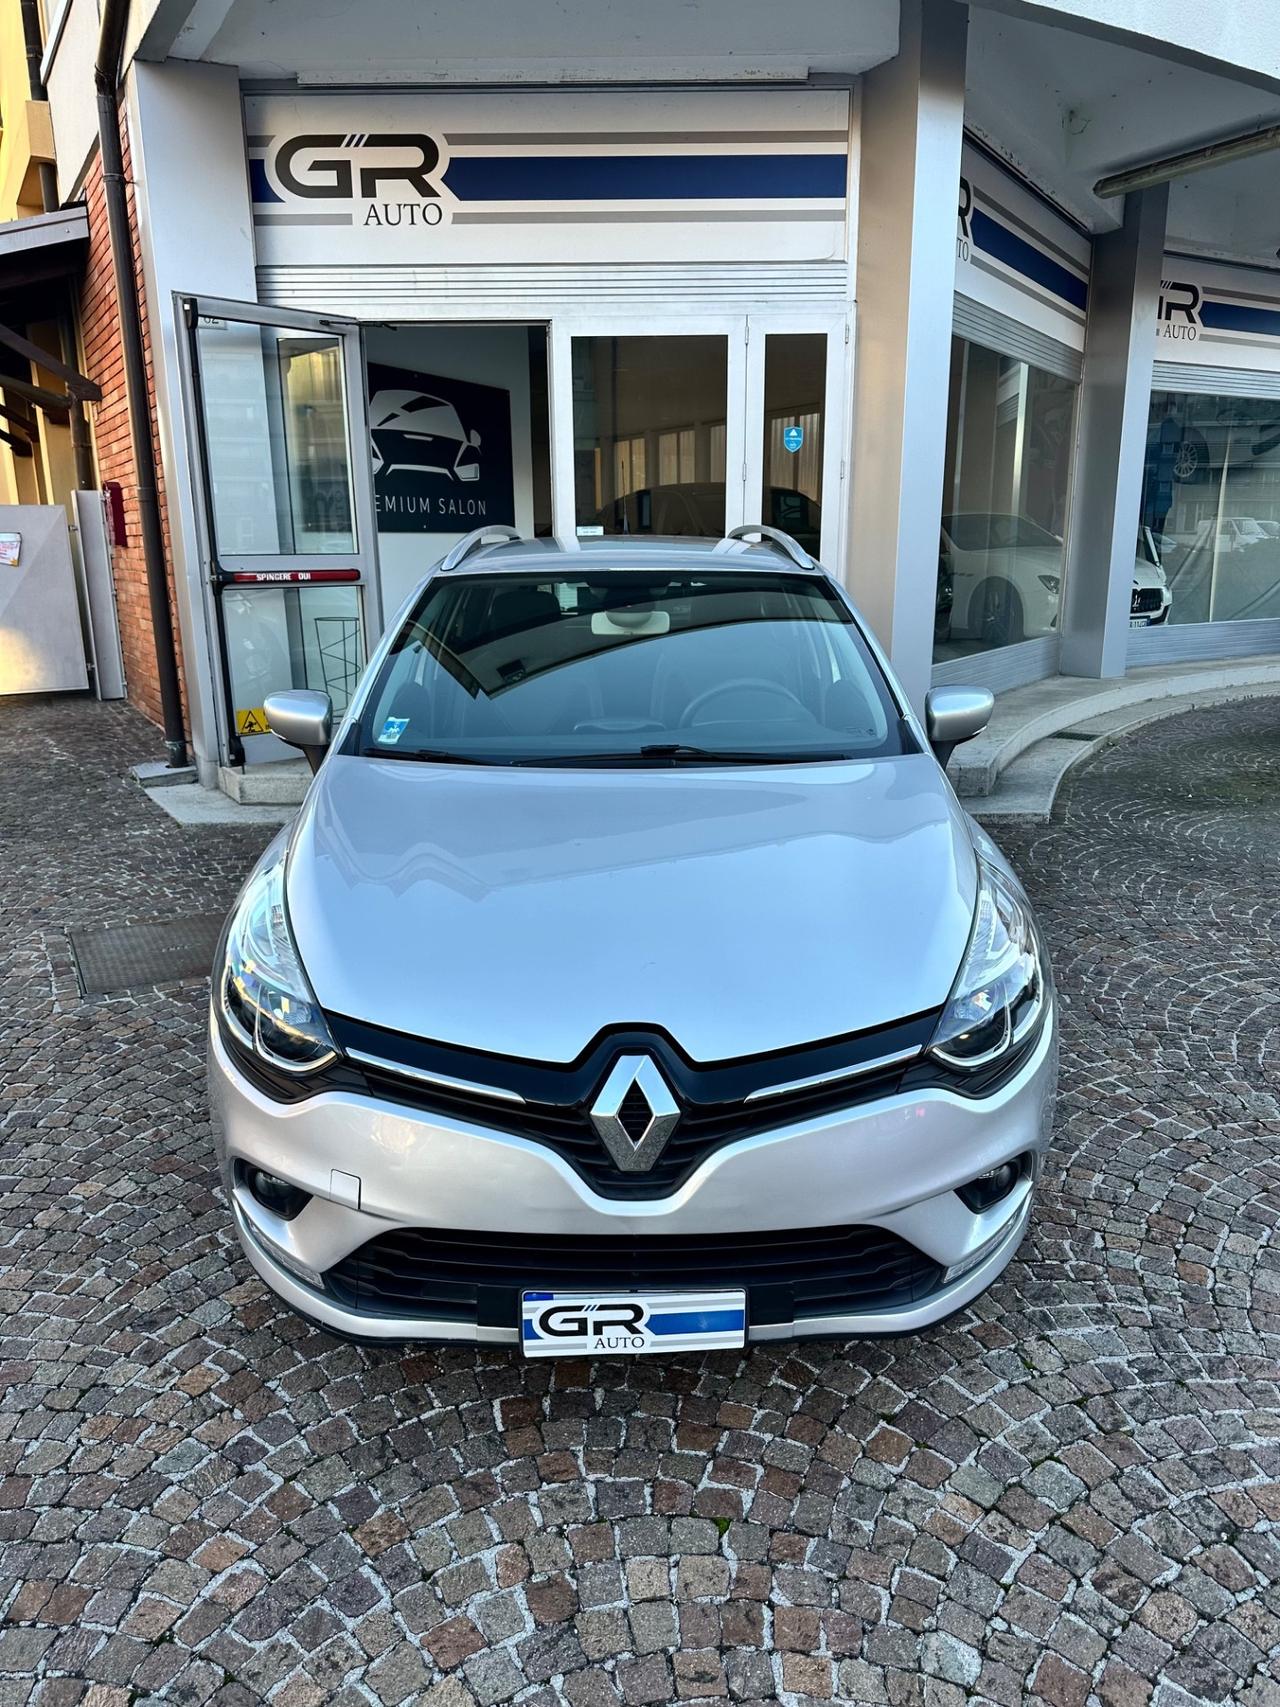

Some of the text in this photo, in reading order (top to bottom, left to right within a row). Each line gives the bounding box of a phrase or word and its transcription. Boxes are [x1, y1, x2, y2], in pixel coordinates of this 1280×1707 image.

[275, 133, 442, 199] GR
[363, 202, 443, 226] AUTO
[1157, 279, 1200, 324] R
[1162, 323, 1197, 341] AUTO
[438, 497, 487, 516] SALON
[538, 1302, 645, 1337] GR
[593, 1336, 646, 1350] AUTO
